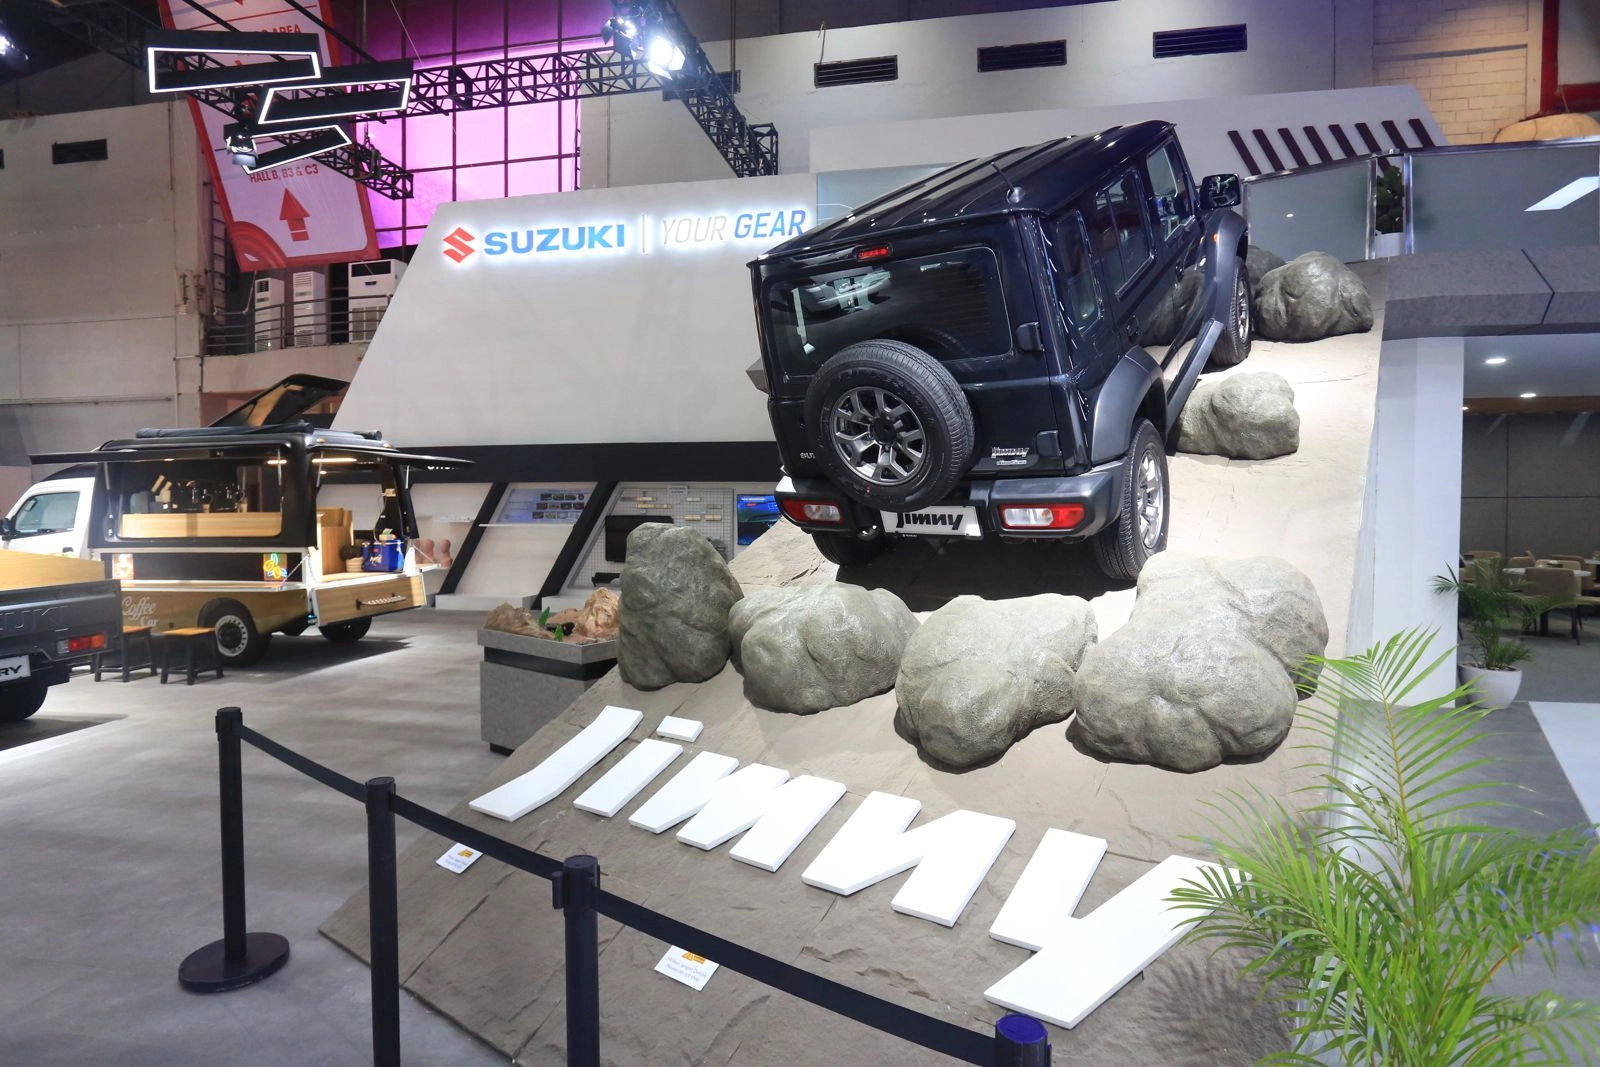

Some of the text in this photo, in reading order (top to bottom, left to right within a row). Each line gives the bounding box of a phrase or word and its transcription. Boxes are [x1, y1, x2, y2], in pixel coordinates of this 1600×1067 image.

[249, 171, 271, 183] HALL
[281, 167, 293, 179] B3
[295, 166, 303, 176] &
[304, 163, 319, 175] C3
[484, 209, 807, 256] SUZUKI YOUR GEAR
[121, 595, 159, 627] Coffee Car
